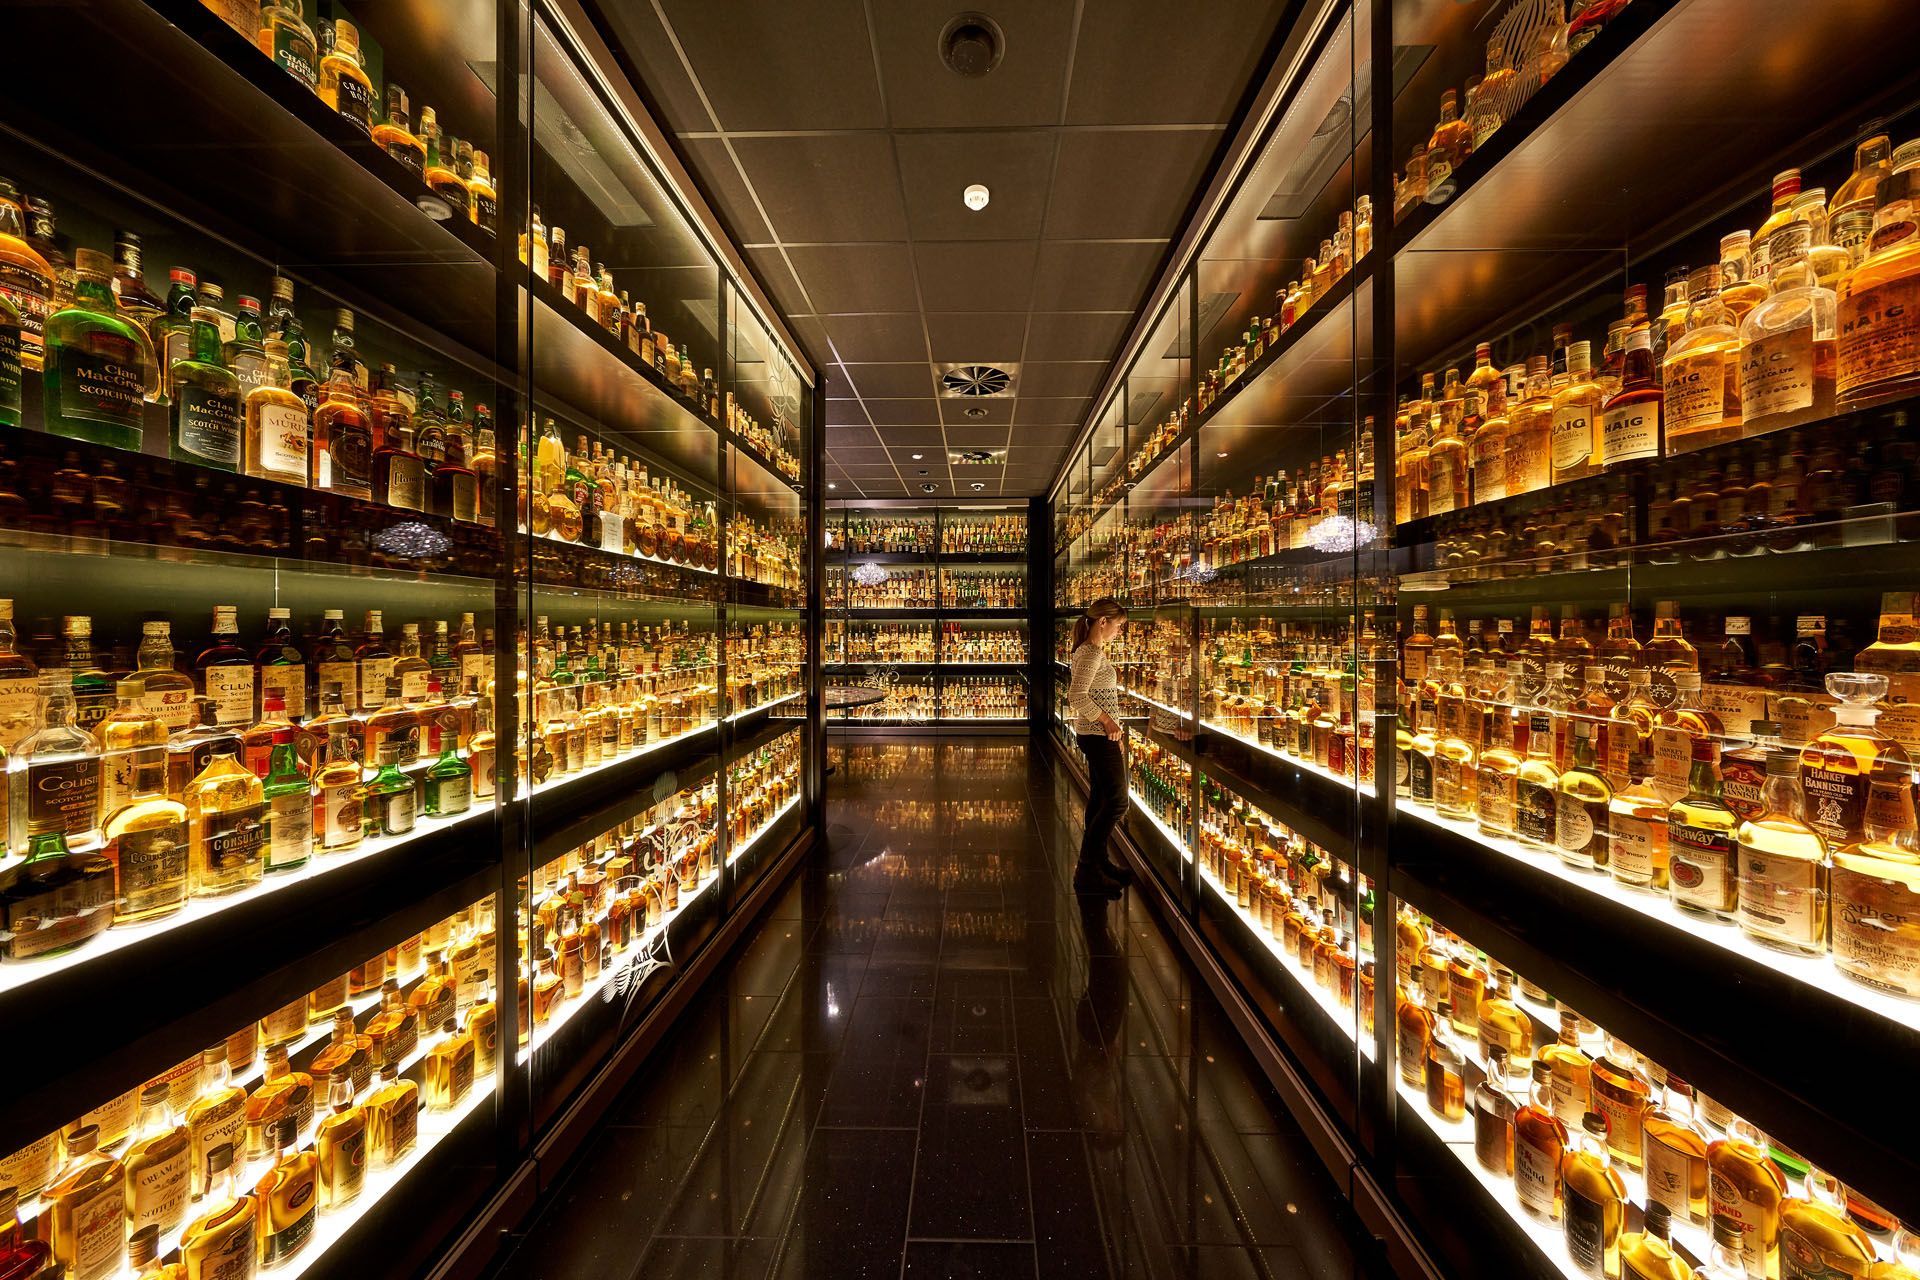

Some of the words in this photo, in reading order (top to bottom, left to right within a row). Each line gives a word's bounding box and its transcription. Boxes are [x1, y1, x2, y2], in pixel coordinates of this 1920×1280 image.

[1843, 304, 1905, 335] HAIG
[1742, 352, 1786, 373] HAIG
[103, 364, 137, 381] Clan
[1665, 372, 1700, 391] HAIG
[79, 384, 123, 400] SCOTCH
[207, 399, 234, 412] Clan
[188, 419, 219, 431] SCOTCH
[1604, 416, 1643, 434] HAIG
[1608, 664, 1630, 678] HAIG
[1738, 771, 1749, 780] 12
[1810, 767, 1847, 783] HANKEY
[1804, 776, 1854, 796] BANNISTER
[45, 795, 82, 806] SCOTCH
[162, 857, 177, 870] 12
[1625, 850, 1648, 860] WHISKY
[1853, 938, 1908, 962] Brothers
[203, 1117, 233, 1142] Crinan
[141, 1164, 174, 1187] CREAM
[140, 1199, 176, 1219] SCOTCH
